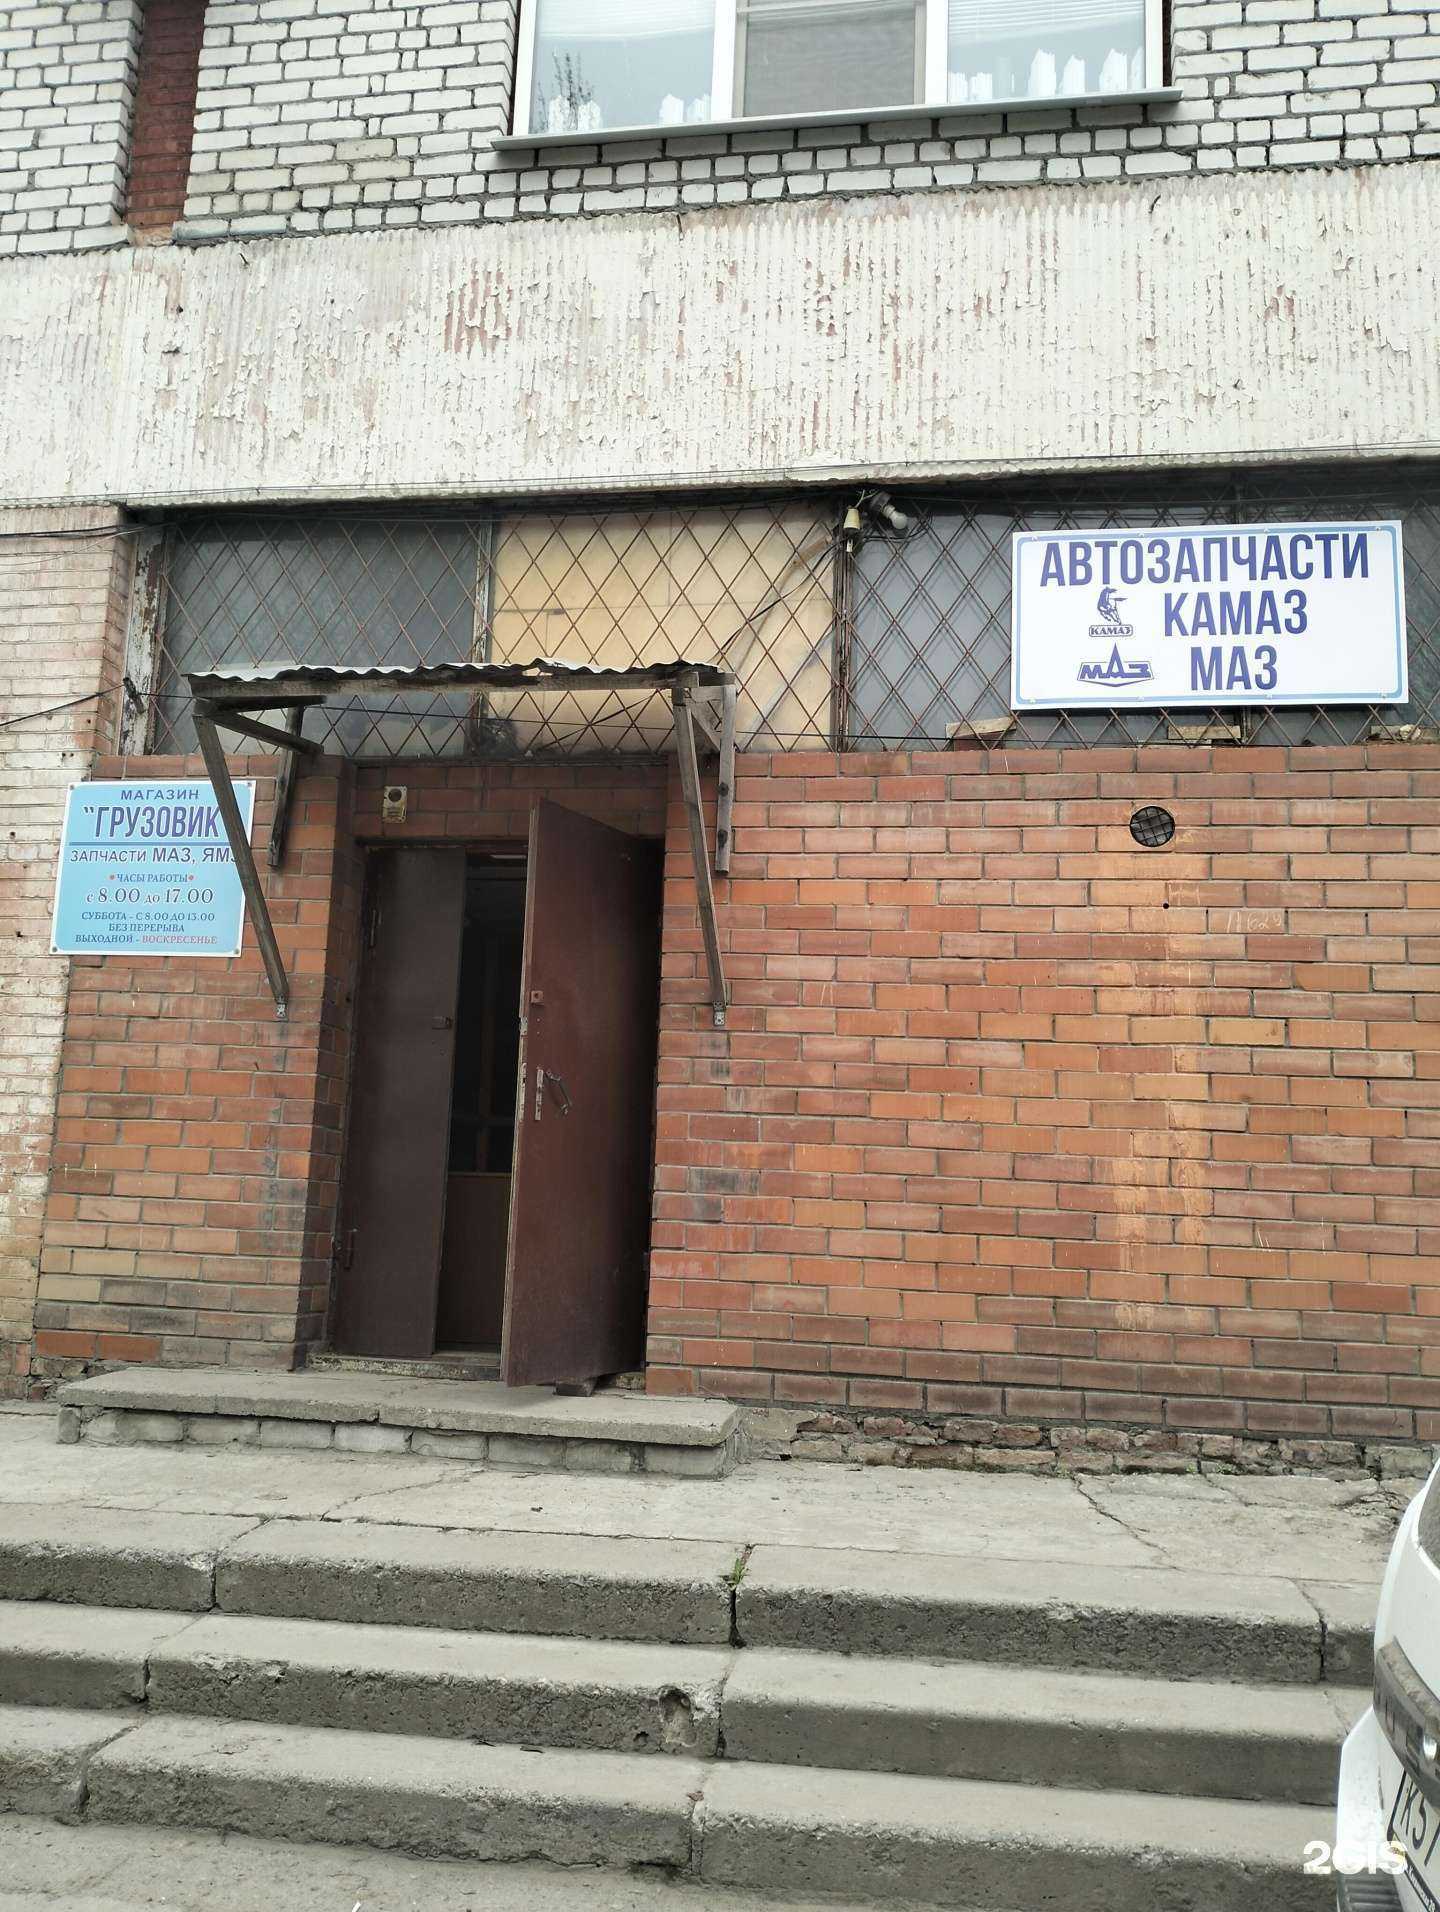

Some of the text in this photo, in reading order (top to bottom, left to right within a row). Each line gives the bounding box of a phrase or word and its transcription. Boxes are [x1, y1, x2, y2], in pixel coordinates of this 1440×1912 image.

[1040, 533, 1370, 587] АВТОЗАПЧАСТИ
[1163, 589, 1308, 637] КАМАЗ
[1090, 626, 1131, 636] КАМАЗ
[1079, 642, 1152, 680] МАЗ
[1190, 644, 1279, 692] МАЗ
[120, 789, 200, 801] МАГАЗИН
[70, 850, 147, 862] ЗАПЧАСТИ
[152, 847, 196, 865] МАЗ,
[116, 873, 188, 883] ЧАСЫ РАБОТЫ
[98, 888, 140, 903] 8.00
[165, 888, 214, 904] 17.00
[81, 911, 127, 921] СУББОТА
[109, 923, 185, 932] БЕЗ ПЕРЕРЫВА
[75, 934, 134, 944] ВЫХОДНОЙ
[142, 935, 218, 945] ВОСКРЕСЕНЬЕ
